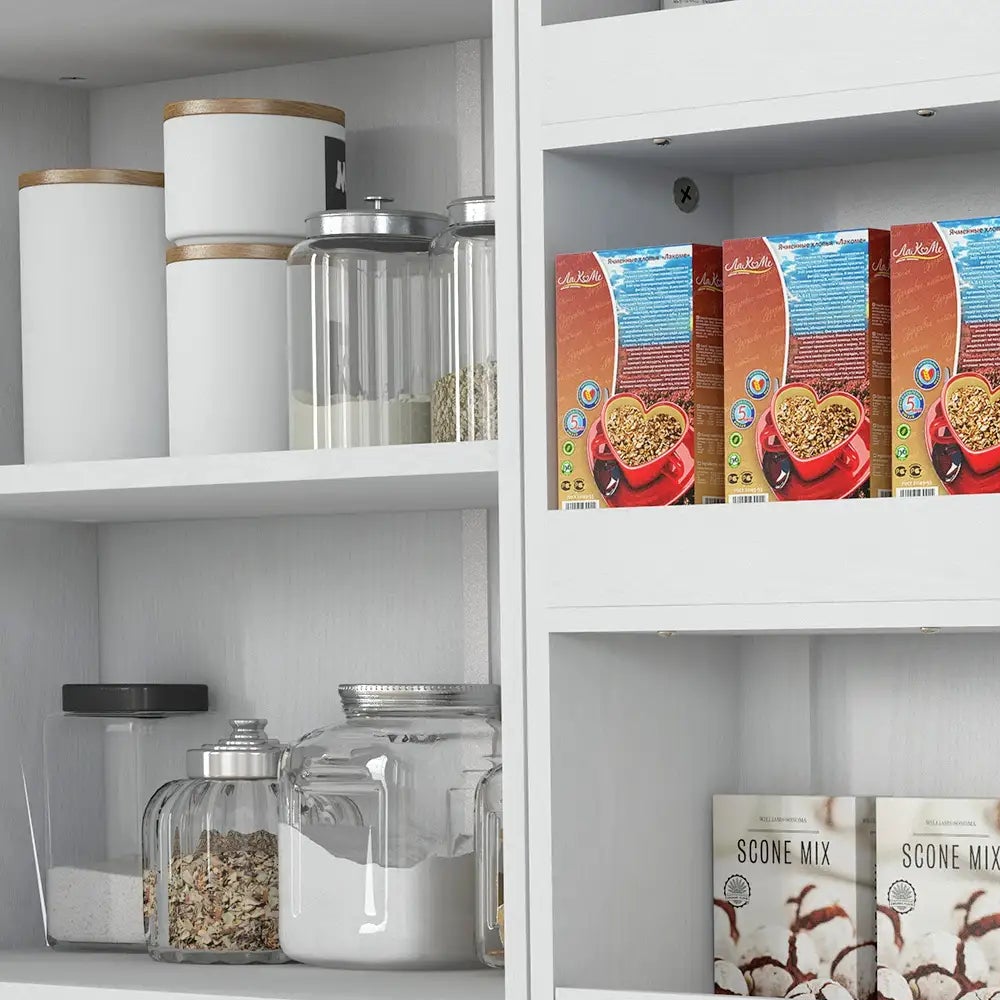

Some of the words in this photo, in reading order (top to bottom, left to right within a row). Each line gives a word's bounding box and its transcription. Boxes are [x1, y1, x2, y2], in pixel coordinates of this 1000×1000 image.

[737, 405, 746, 421] 5
[905, 395, 915, 412] 5
[737, 838, 792, 864] SCONE
[800, 840, 831, 865] MIX
[902, 842, 960, 870] SCONE
[969, 844, 1000, 871] MIX
